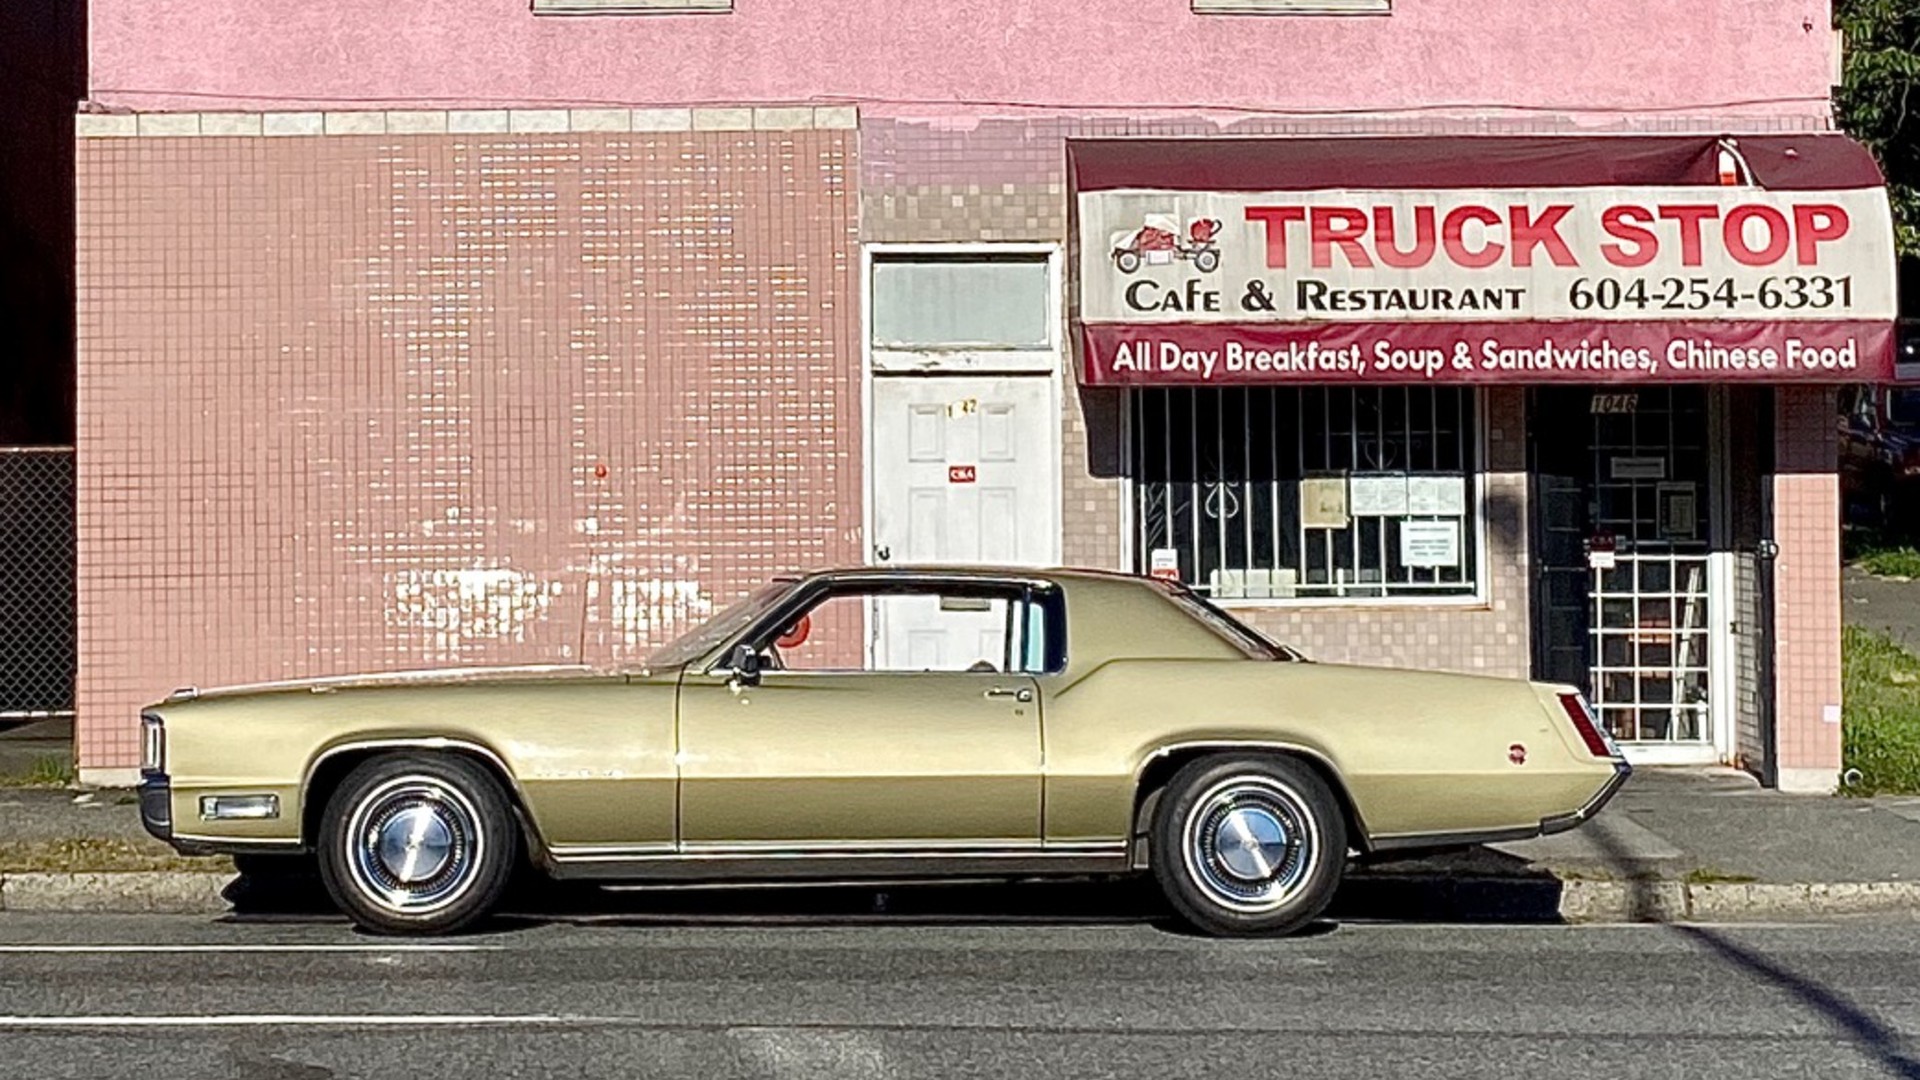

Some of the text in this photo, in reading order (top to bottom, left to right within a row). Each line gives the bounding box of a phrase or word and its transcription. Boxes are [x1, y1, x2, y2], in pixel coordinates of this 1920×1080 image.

[1244, 204, 1850, 270] TRUCK STOP
[1240, 278, 1277, 312] &
[1569, 275, 1853, 311] 604-254-6331
[1112, 338, 1857, 379] All Day Breakfast, Soup & Sandwiches, Chinese Food
[1594, 394, 1637, 412] 1046
